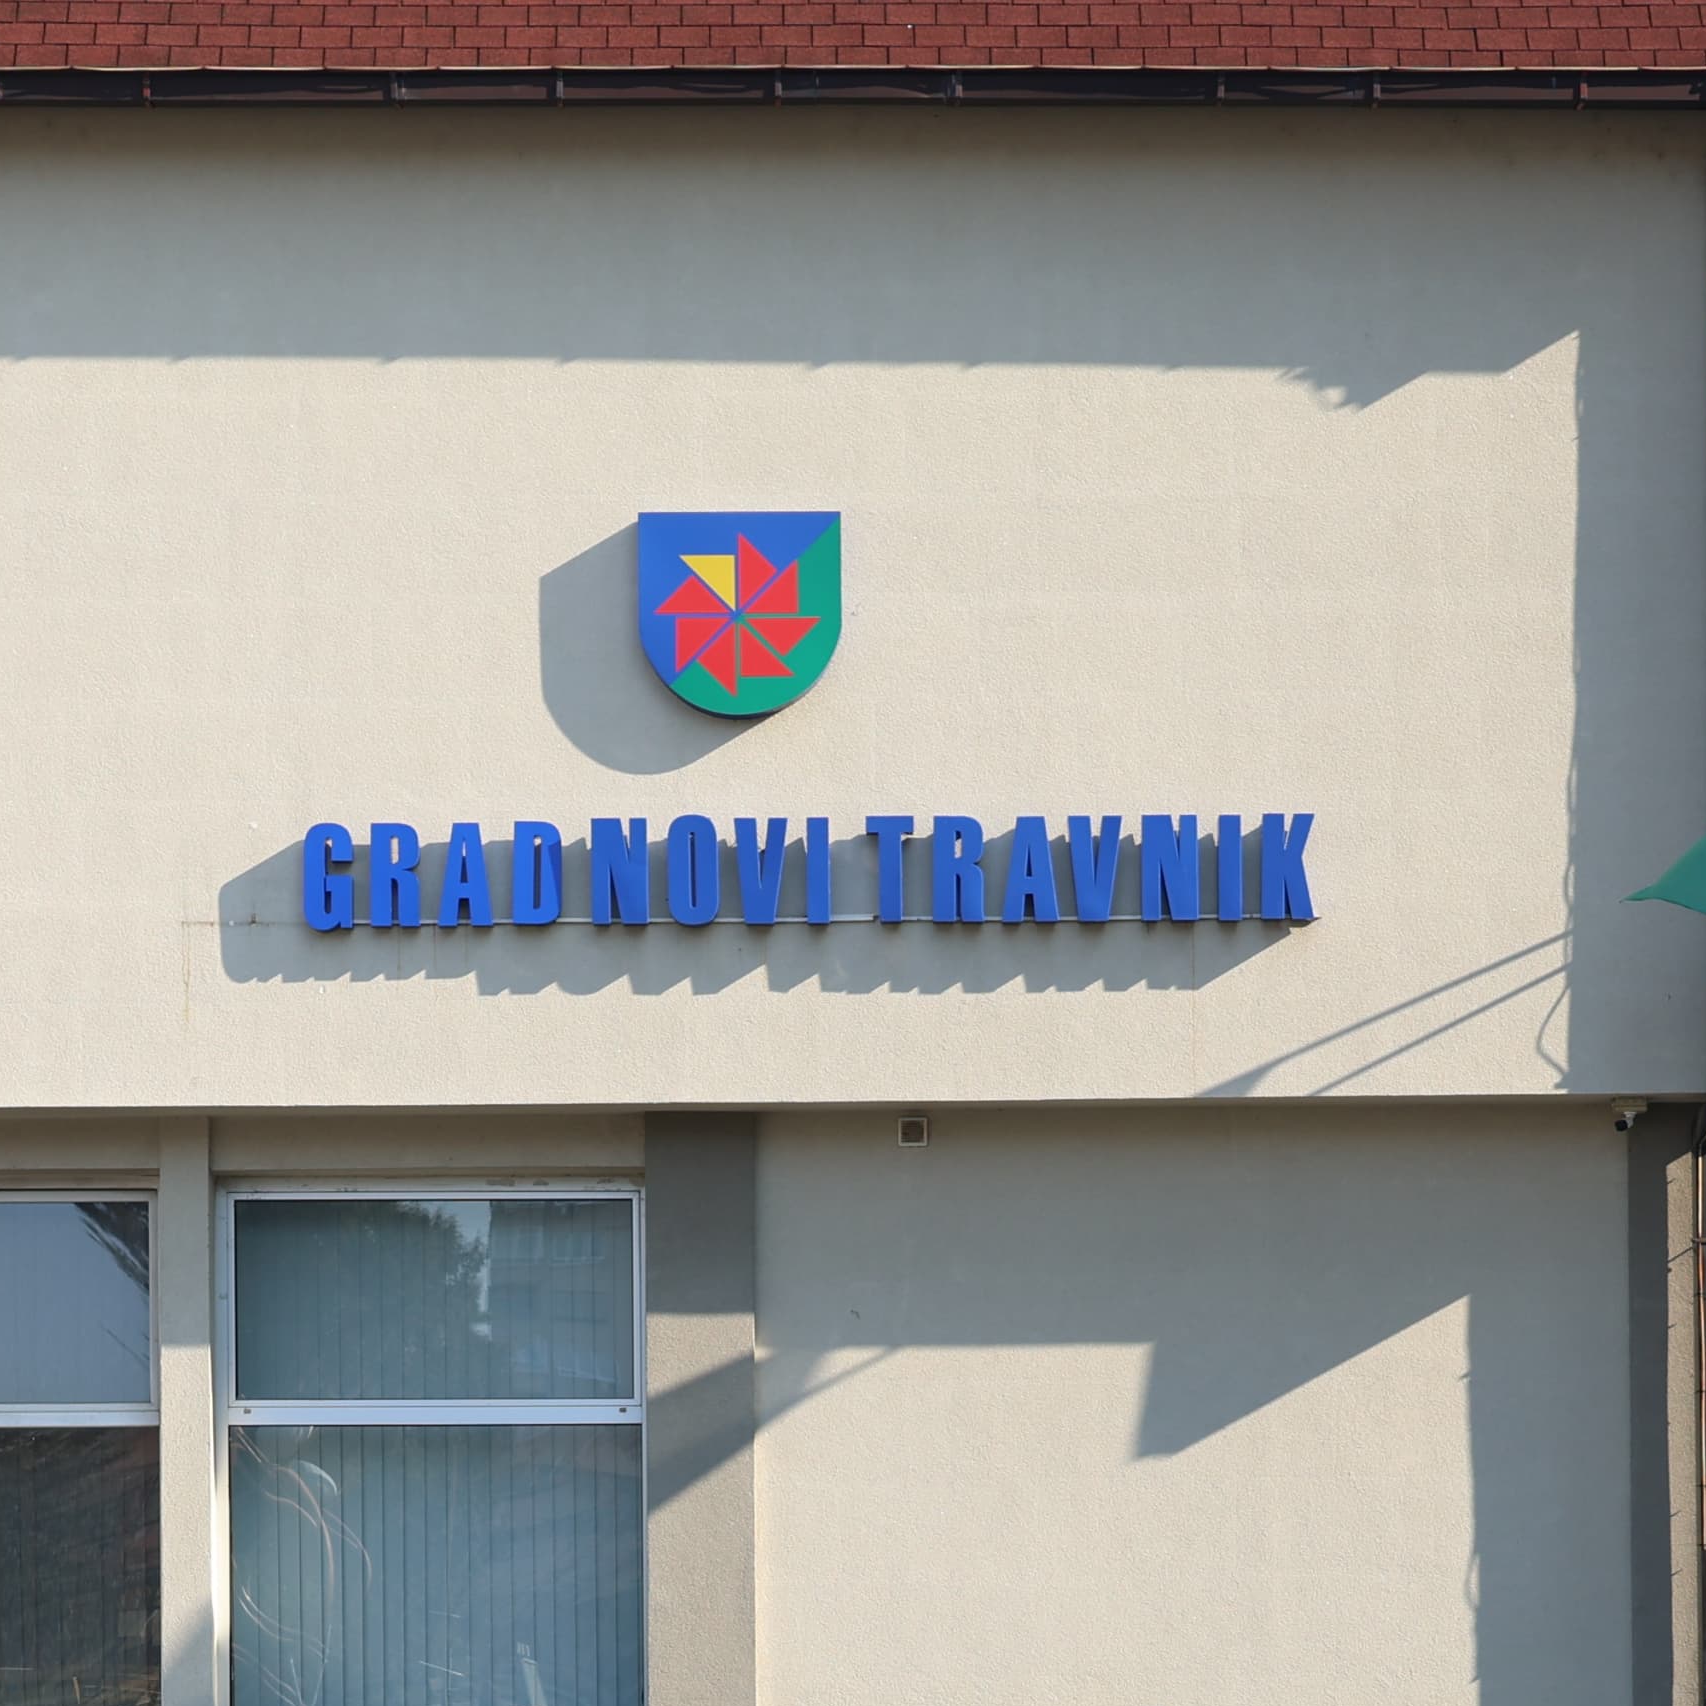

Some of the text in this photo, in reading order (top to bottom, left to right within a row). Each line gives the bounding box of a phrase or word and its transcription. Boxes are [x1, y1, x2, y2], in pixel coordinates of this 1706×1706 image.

[302, 812, 1316, 932] GRAD NOVI TRAVNIK
